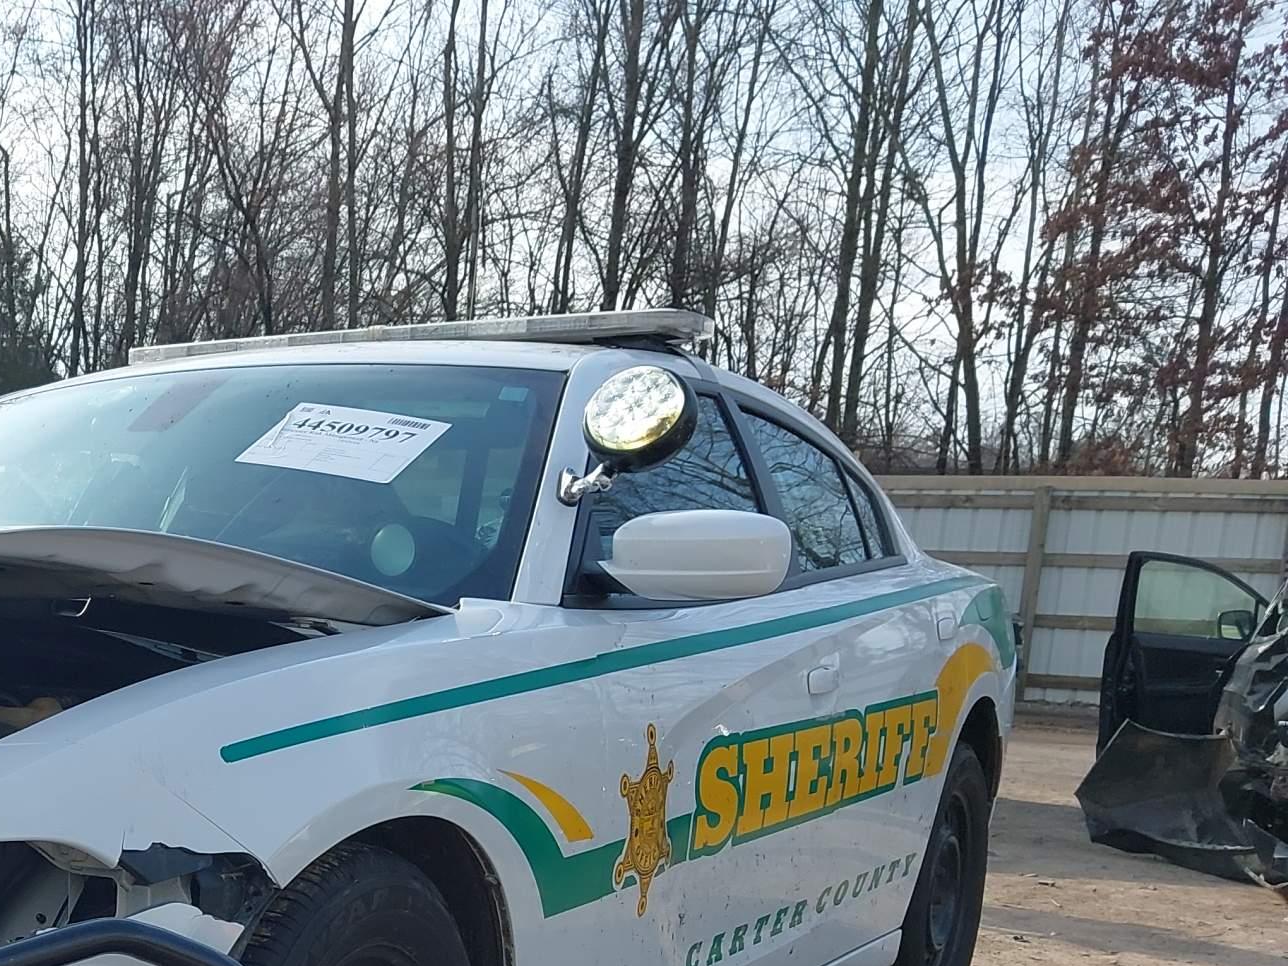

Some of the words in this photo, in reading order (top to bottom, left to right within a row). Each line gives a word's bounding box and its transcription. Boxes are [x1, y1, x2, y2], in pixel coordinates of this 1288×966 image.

[293, 418, 417, 444] 44509797
[693, 697, 938, 851] SHERIFF
[815, 851, 918, 915] COUNTY
